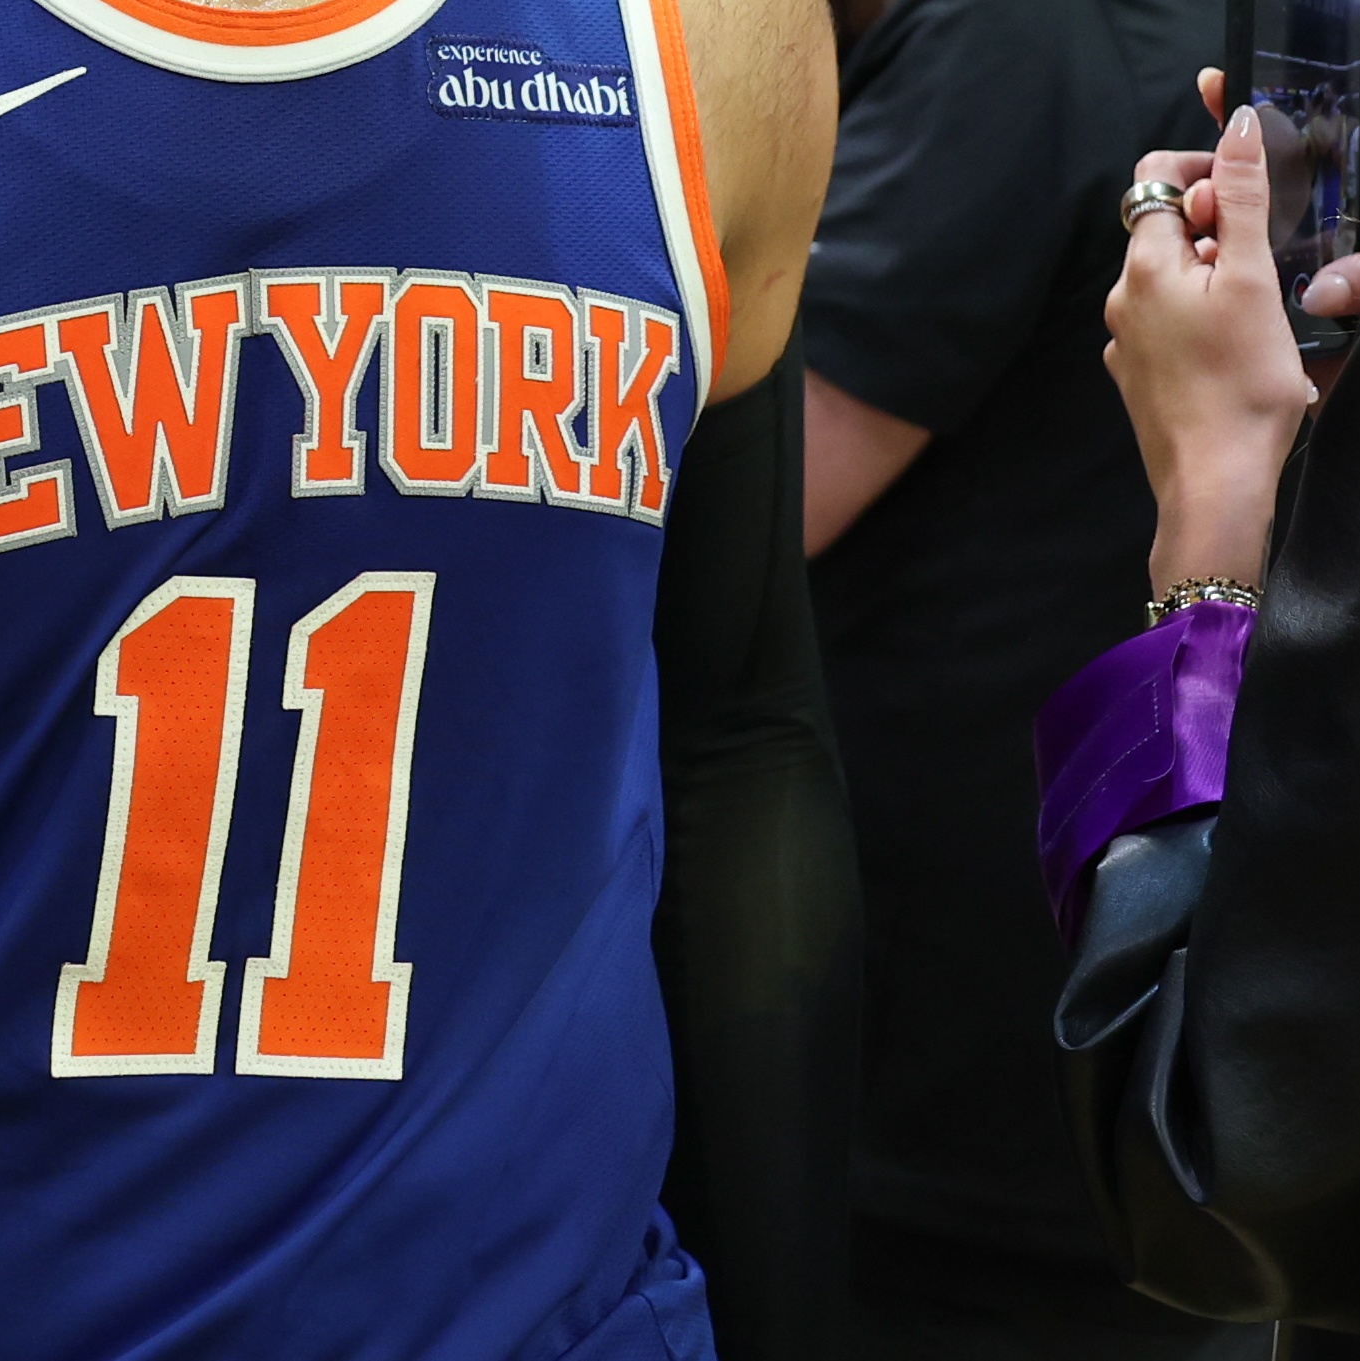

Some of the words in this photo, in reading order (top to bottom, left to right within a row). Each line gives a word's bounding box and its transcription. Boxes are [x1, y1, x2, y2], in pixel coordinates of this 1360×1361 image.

[437, 42, 543, 67] experience
[439, 66, 516, 111] abu
[520, 71, 632, 116] dhabi
[251, 268, 680, 527] YORK
[52, 571, 436, 1081] 11
